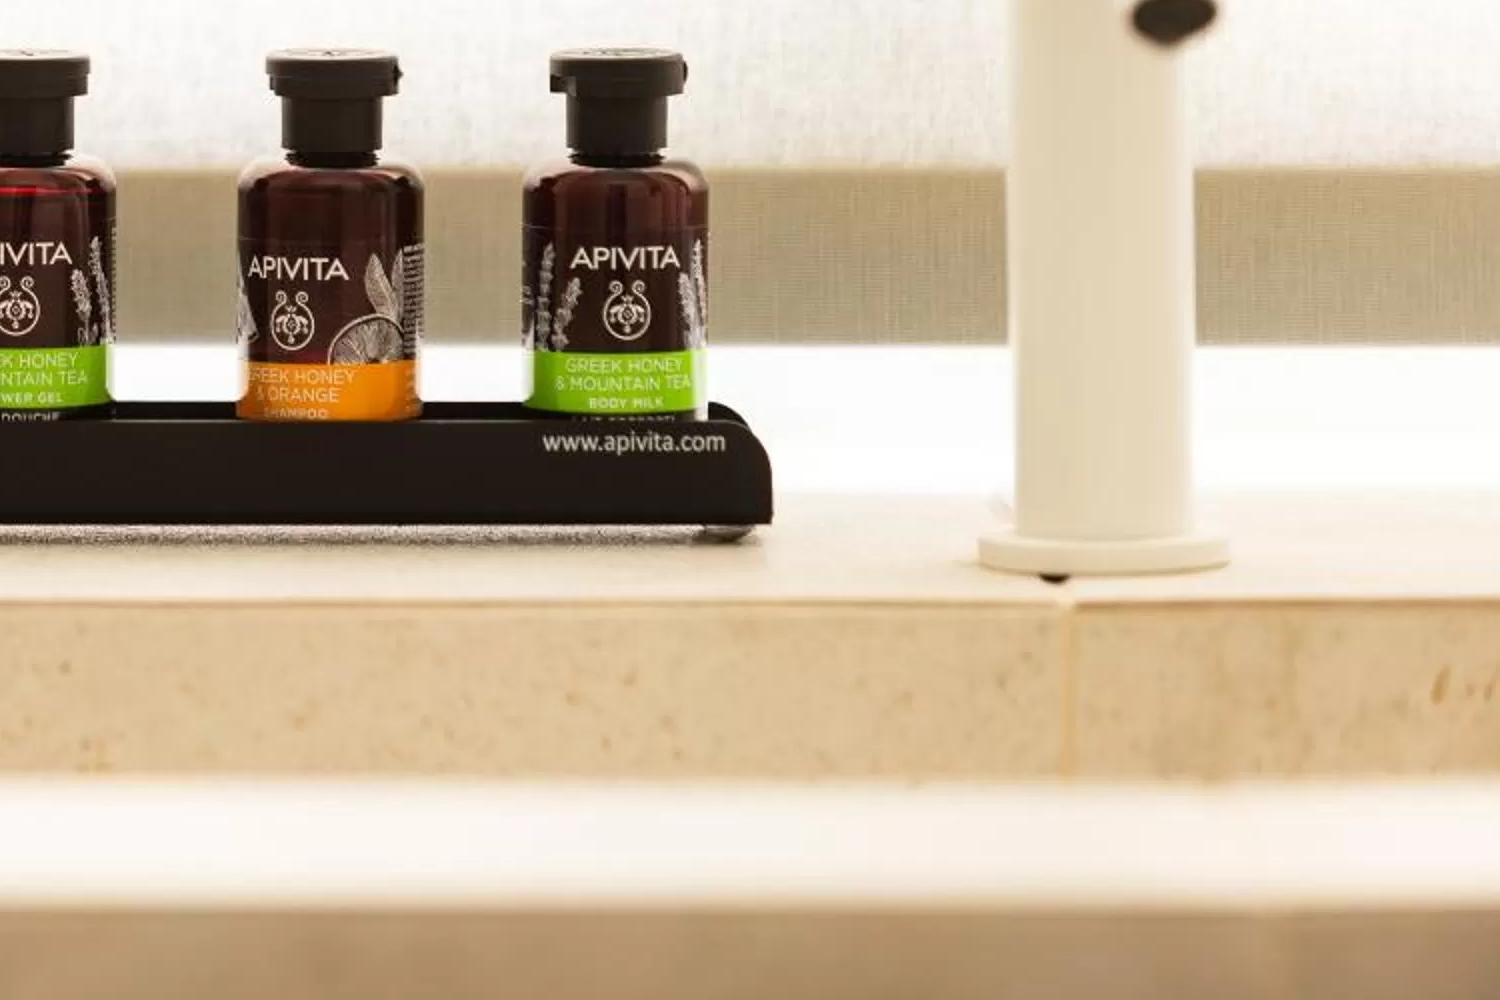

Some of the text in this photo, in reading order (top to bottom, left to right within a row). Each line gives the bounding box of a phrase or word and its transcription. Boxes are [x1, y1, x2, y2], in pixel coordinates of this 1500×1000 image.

[569, 245, 681, 270] APIVITA
[248, 255, 350, 281] APIVITA
[19, 352, 79, 368] HONEY
[566, 358, 684, 374] GREEK HONEY
[58, 370, 89, 386] TEA
[295, 369, 356, 385] HONEY
[569, 375, 662, 392] MOUNTAIN
[666, 374, 693, 390] TEA
[37, 391, 63, 404] GEL
[267, 385, 342, 404] ORANGE
[588, 397, 665, 410] BODY MILK
[542, 431, 727, 456] www.apivita.com
